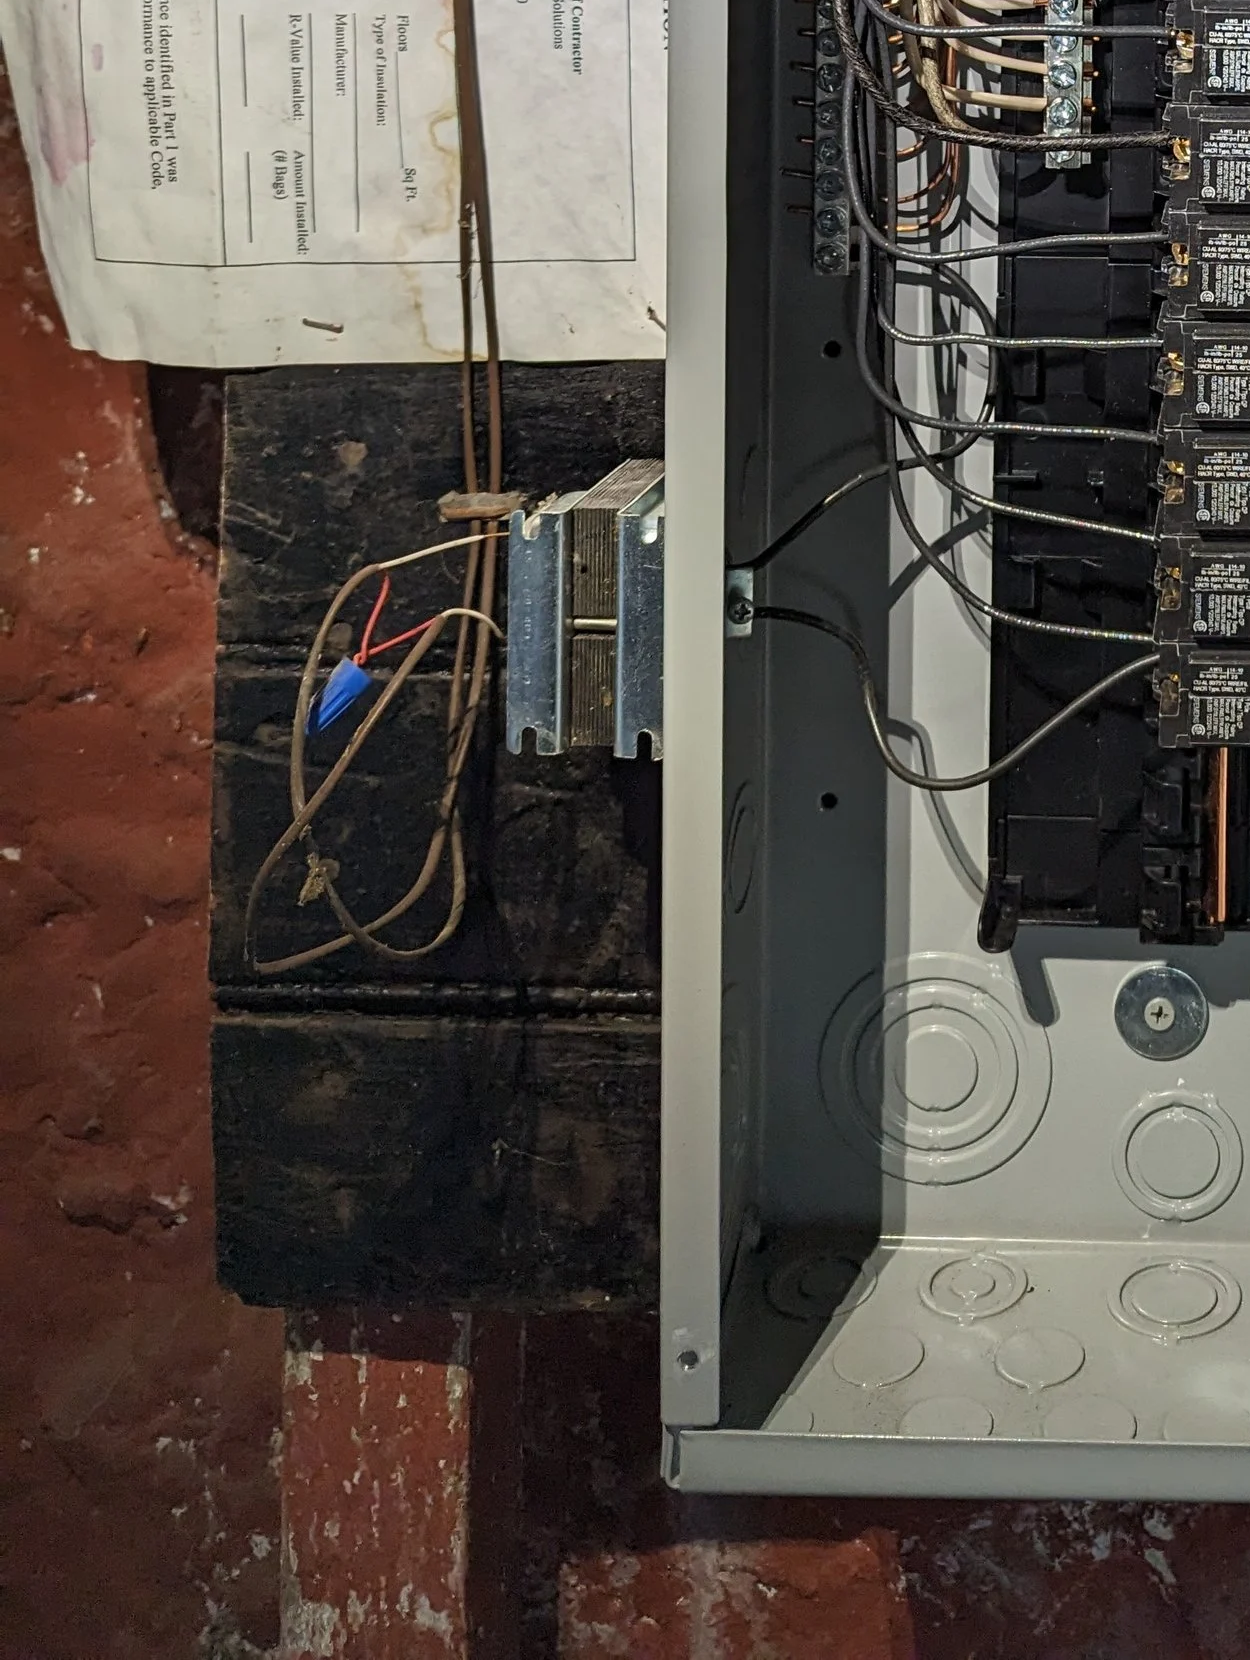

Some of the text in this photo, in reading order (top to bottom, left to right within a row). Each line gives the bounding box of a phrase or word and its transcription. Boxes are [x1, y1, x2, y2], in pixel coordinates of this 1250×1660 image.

[158, 24, 175, 90] identified
[335, 13, 348, 97] Manufacturer:
[397, 14, 410, 52] Floors
[571, 5, 585, 75] Contractor
[149, 150, 165, 190] Code,
